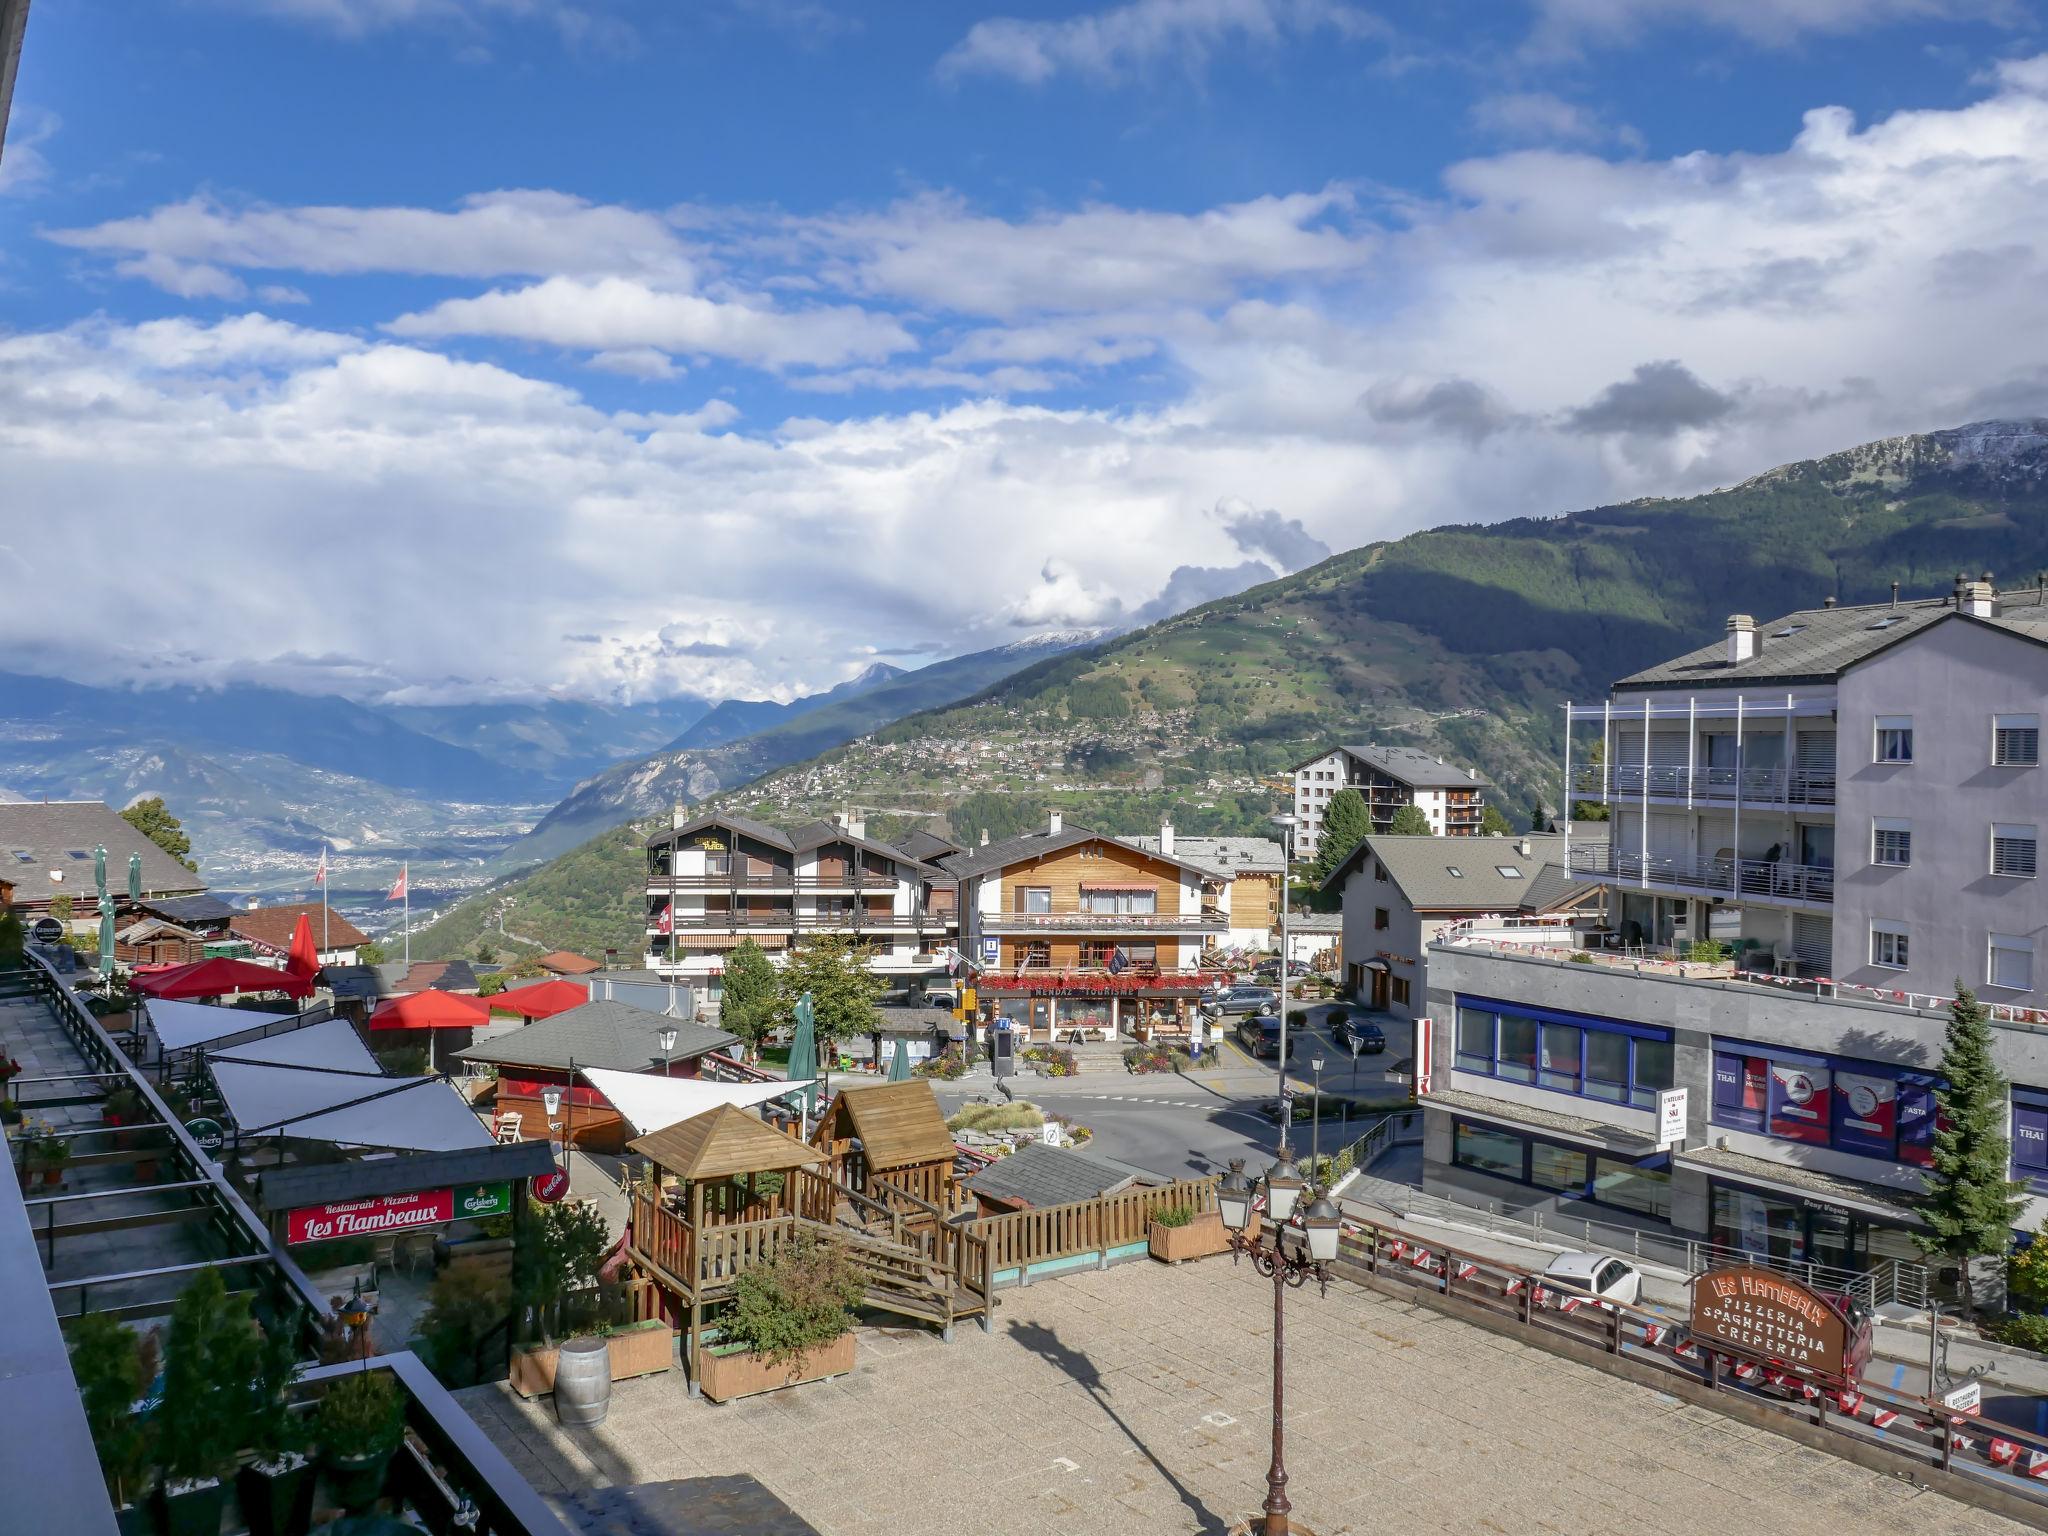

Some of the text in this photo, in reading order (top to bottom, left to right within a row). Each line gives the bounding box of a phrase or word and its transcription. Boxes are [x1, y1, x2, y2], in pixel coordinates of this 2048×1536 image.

[1035, 988, 1134, 996] NENDAZ TOURISME
[1716, 1073, 1736, 1084] THAI
[1745, 1080, 1766, 1090] HOUSE
[1904, 1106, 1927, 1116] PASTA
[2019, 1128, 2045, 1141] THAI
[325, 1198, 375, 1215] Restaurant
[383, 1193, 419, 1207] Pizzeria
[464, 1195, 498, 1211] Carlsberg
[304, 1206, 439, 1240] Les Flambeaux
[1711, 1276, 1828, 1328] LES FLAMBEAUX
[1723, 1297, 1804, 1331] PIZZERIA
[1703, 1307, 1825, 1353] SPAGHETTERIA
[1717, 1324, 1809, 1361] CREPERIA
